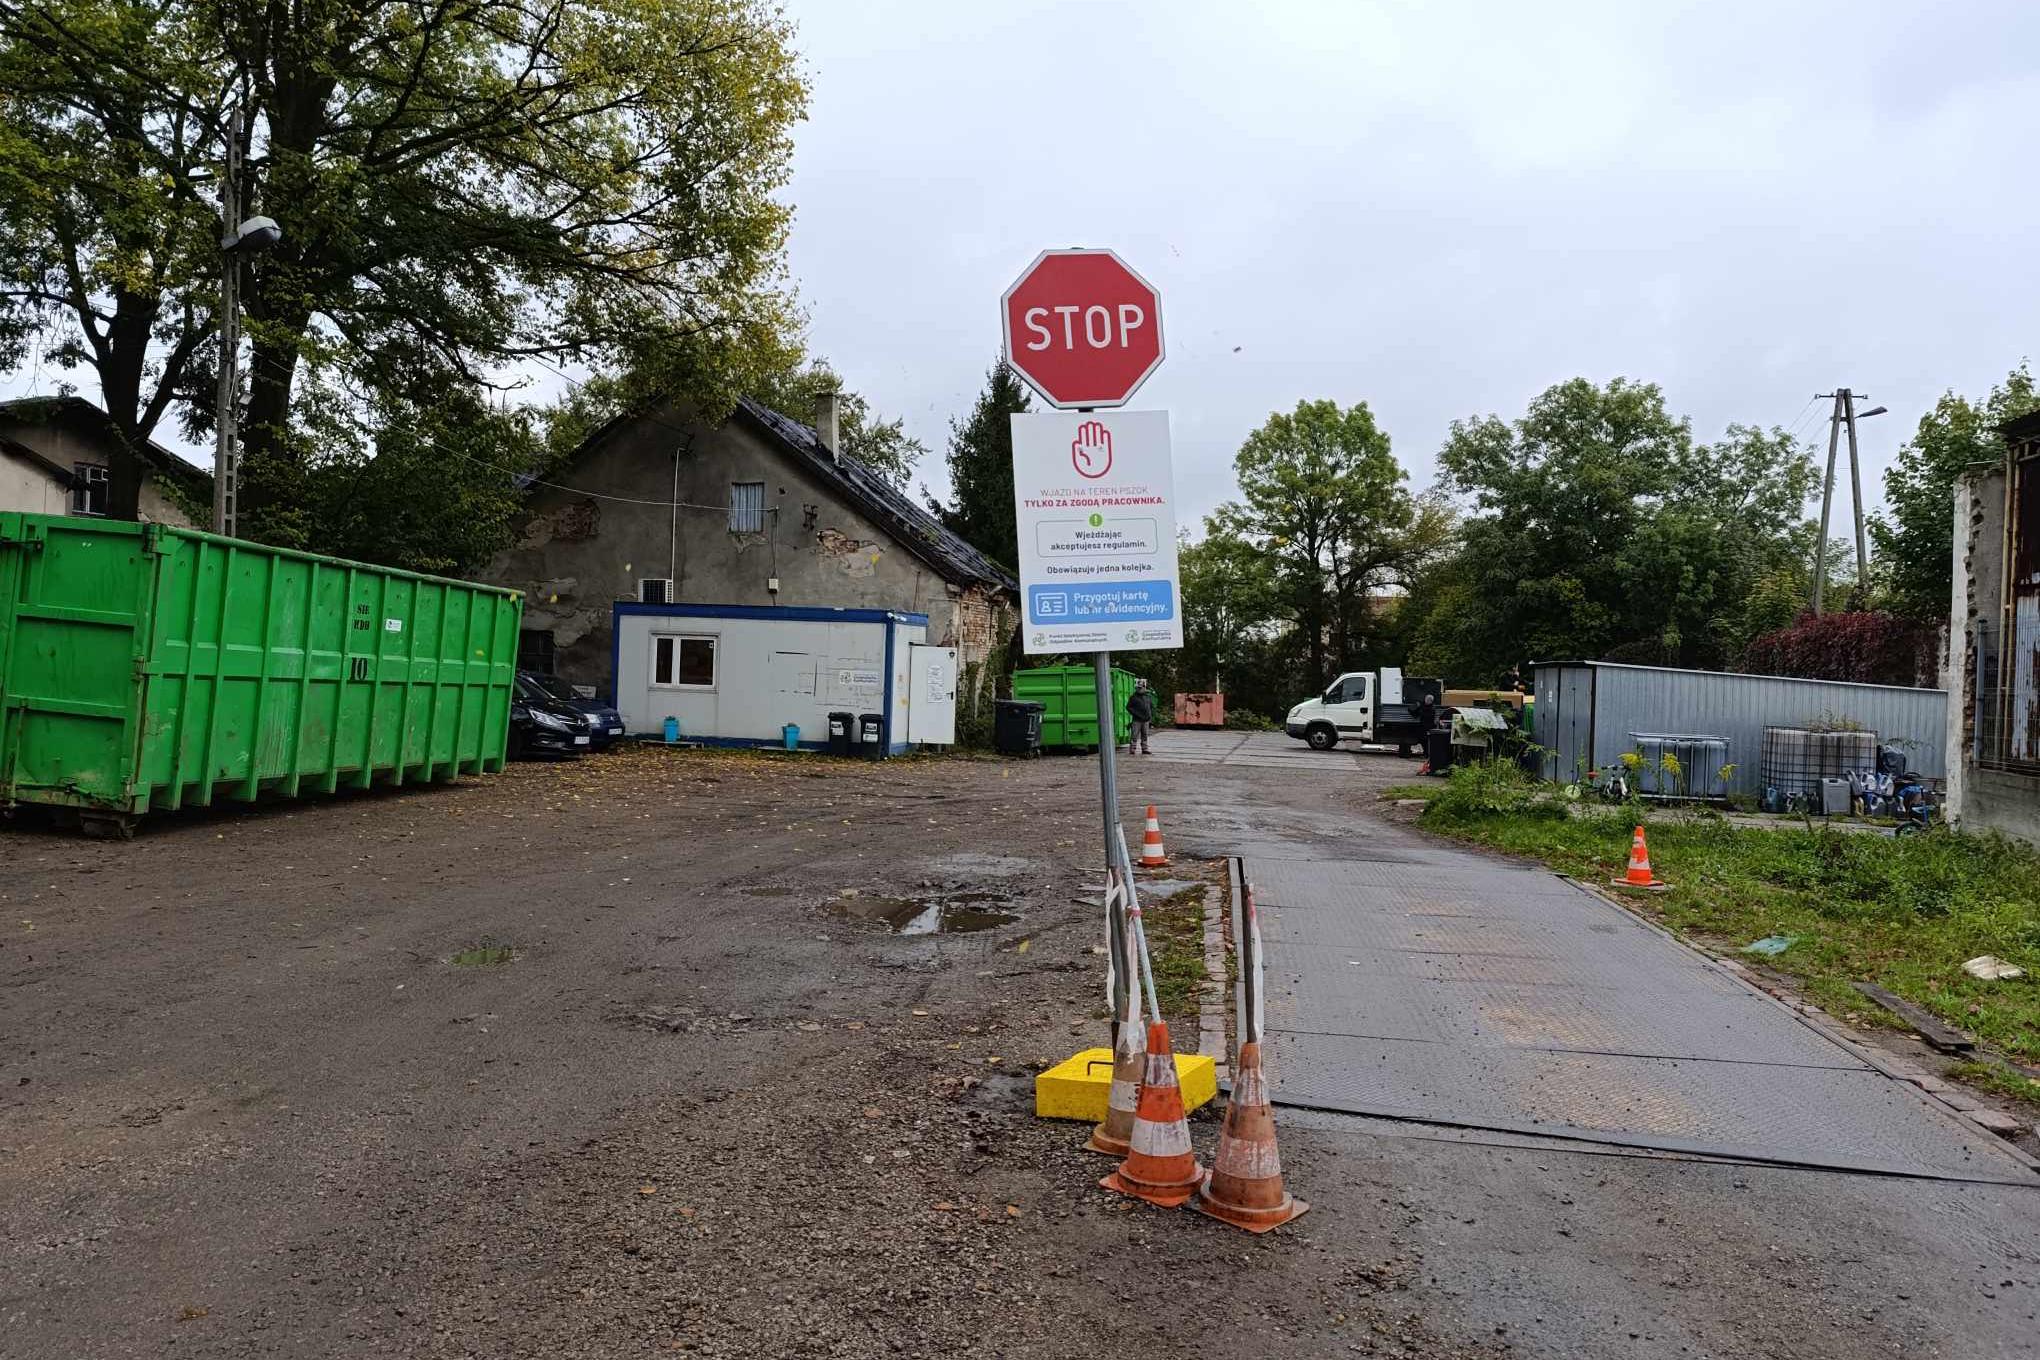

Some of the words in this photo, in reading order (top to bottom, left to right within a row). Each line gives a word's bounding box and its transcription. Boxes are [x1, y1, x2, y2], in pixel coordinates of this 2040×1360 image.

[1025, 304, 1144, 351] STOP
[1040, 488, 1072, 497] WJAZD
[1073, 488, 1086, 496] NA
[1088, 487, 1117, 496] TEREN
[1024, 499, 1054, 508] TYLKO
[1056, 499, 1068, 507] ZA
[1070, 498, 1100, 507] ZGODĄ
[1101, 496, 1165, 506] PRACOWNIKA.
[1050, 542, 1101, 551] akceptujesz
[1103, 539, 1147, 550] regulamin.
[1047, 564, 1095, 575] Obowiązuje
[1096, 564, 1120, 574] jedna
[1121, 562, 1154, 573] kolejka.
[1073, 590, 1120, 604] Przygotuj
[1122, 590, 1149, 602] kartę
[1075, 604, 1090, 615] lub
[1092, 605, 1102, 615] nr
[1104, 602, 1168, 615] ewidencyjny.
[351, 657, 368, 681] 10
